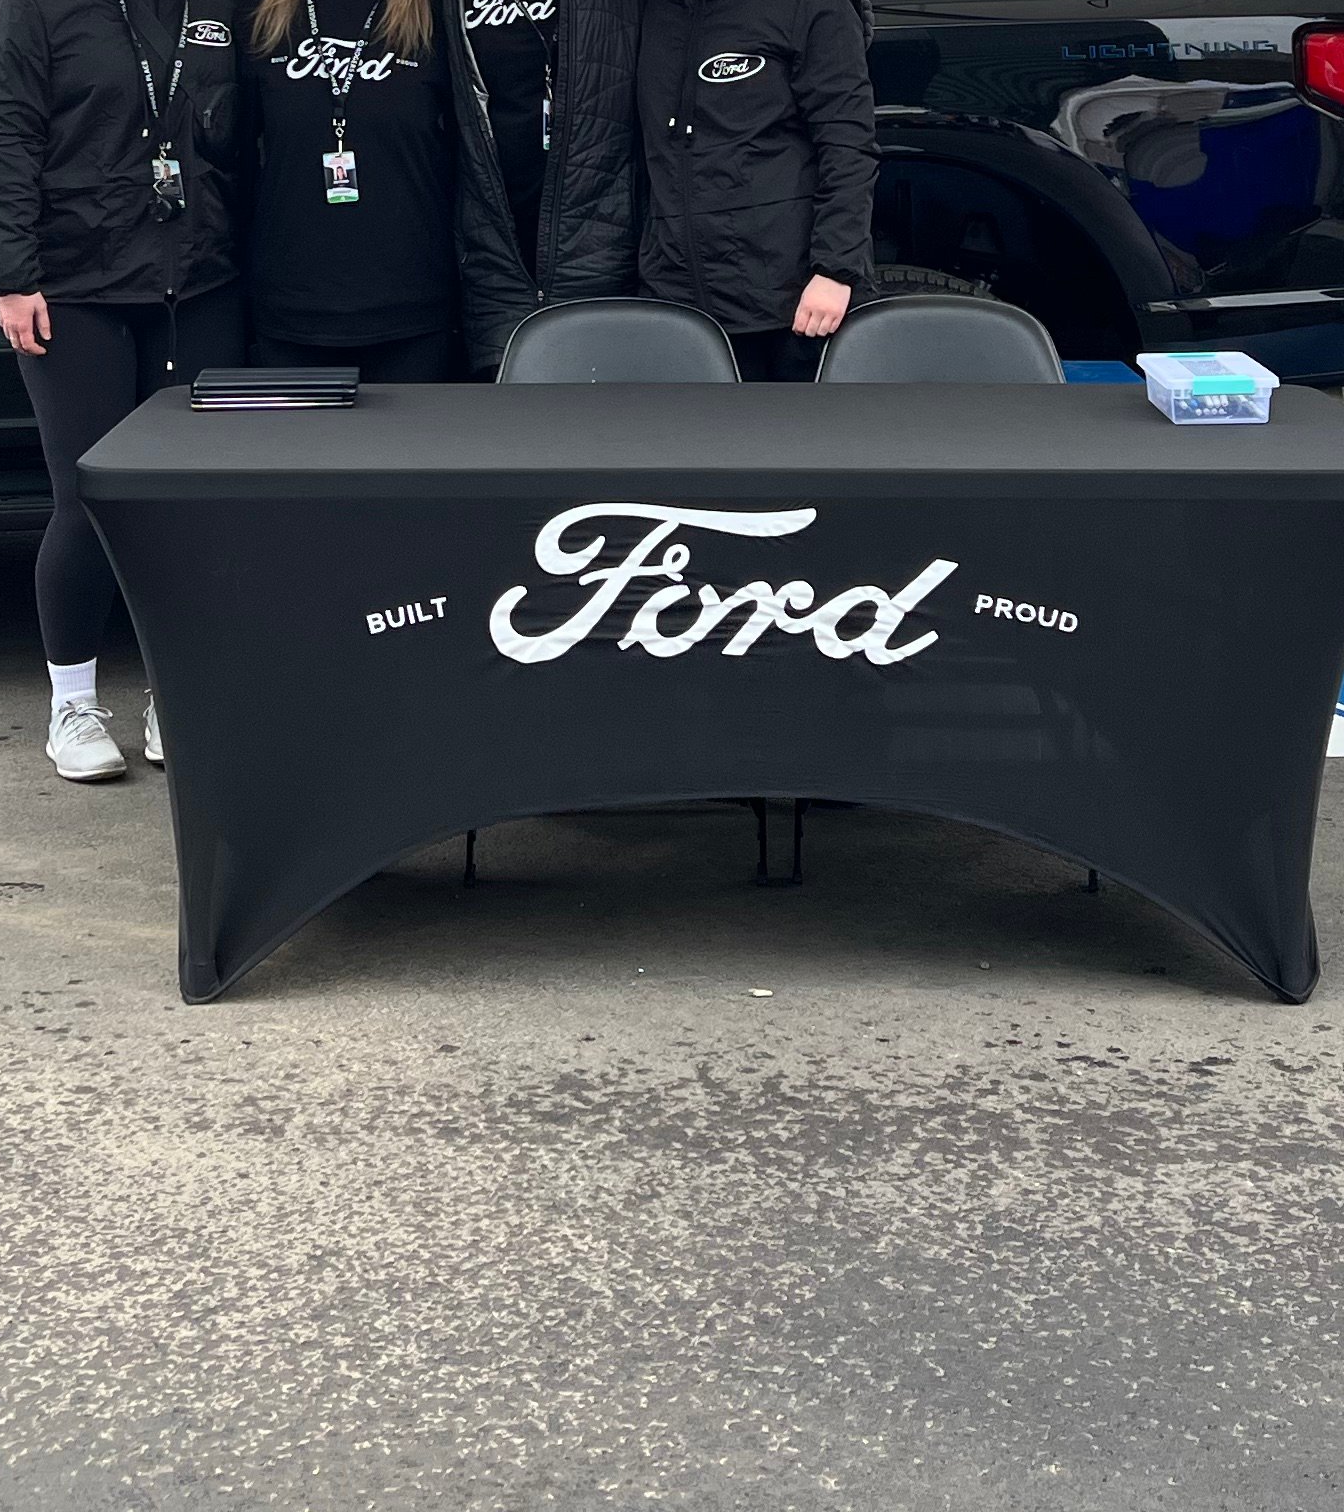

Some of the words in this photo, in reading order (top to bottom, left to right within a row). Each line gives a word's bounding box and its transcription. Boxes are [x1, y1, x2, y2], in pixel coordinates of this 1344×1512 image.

[195, 24, 227, 42] Ford
[286, 37, 395, 81] Ford
[1061, 40, 1279, 61] LIGHTNING
[712, 57, 750, 78] Ford
[365, 596, 449, 636] BUILT
[488, 502, 959, 665] Ford
[973, 593, 1080, 635] PROUD
